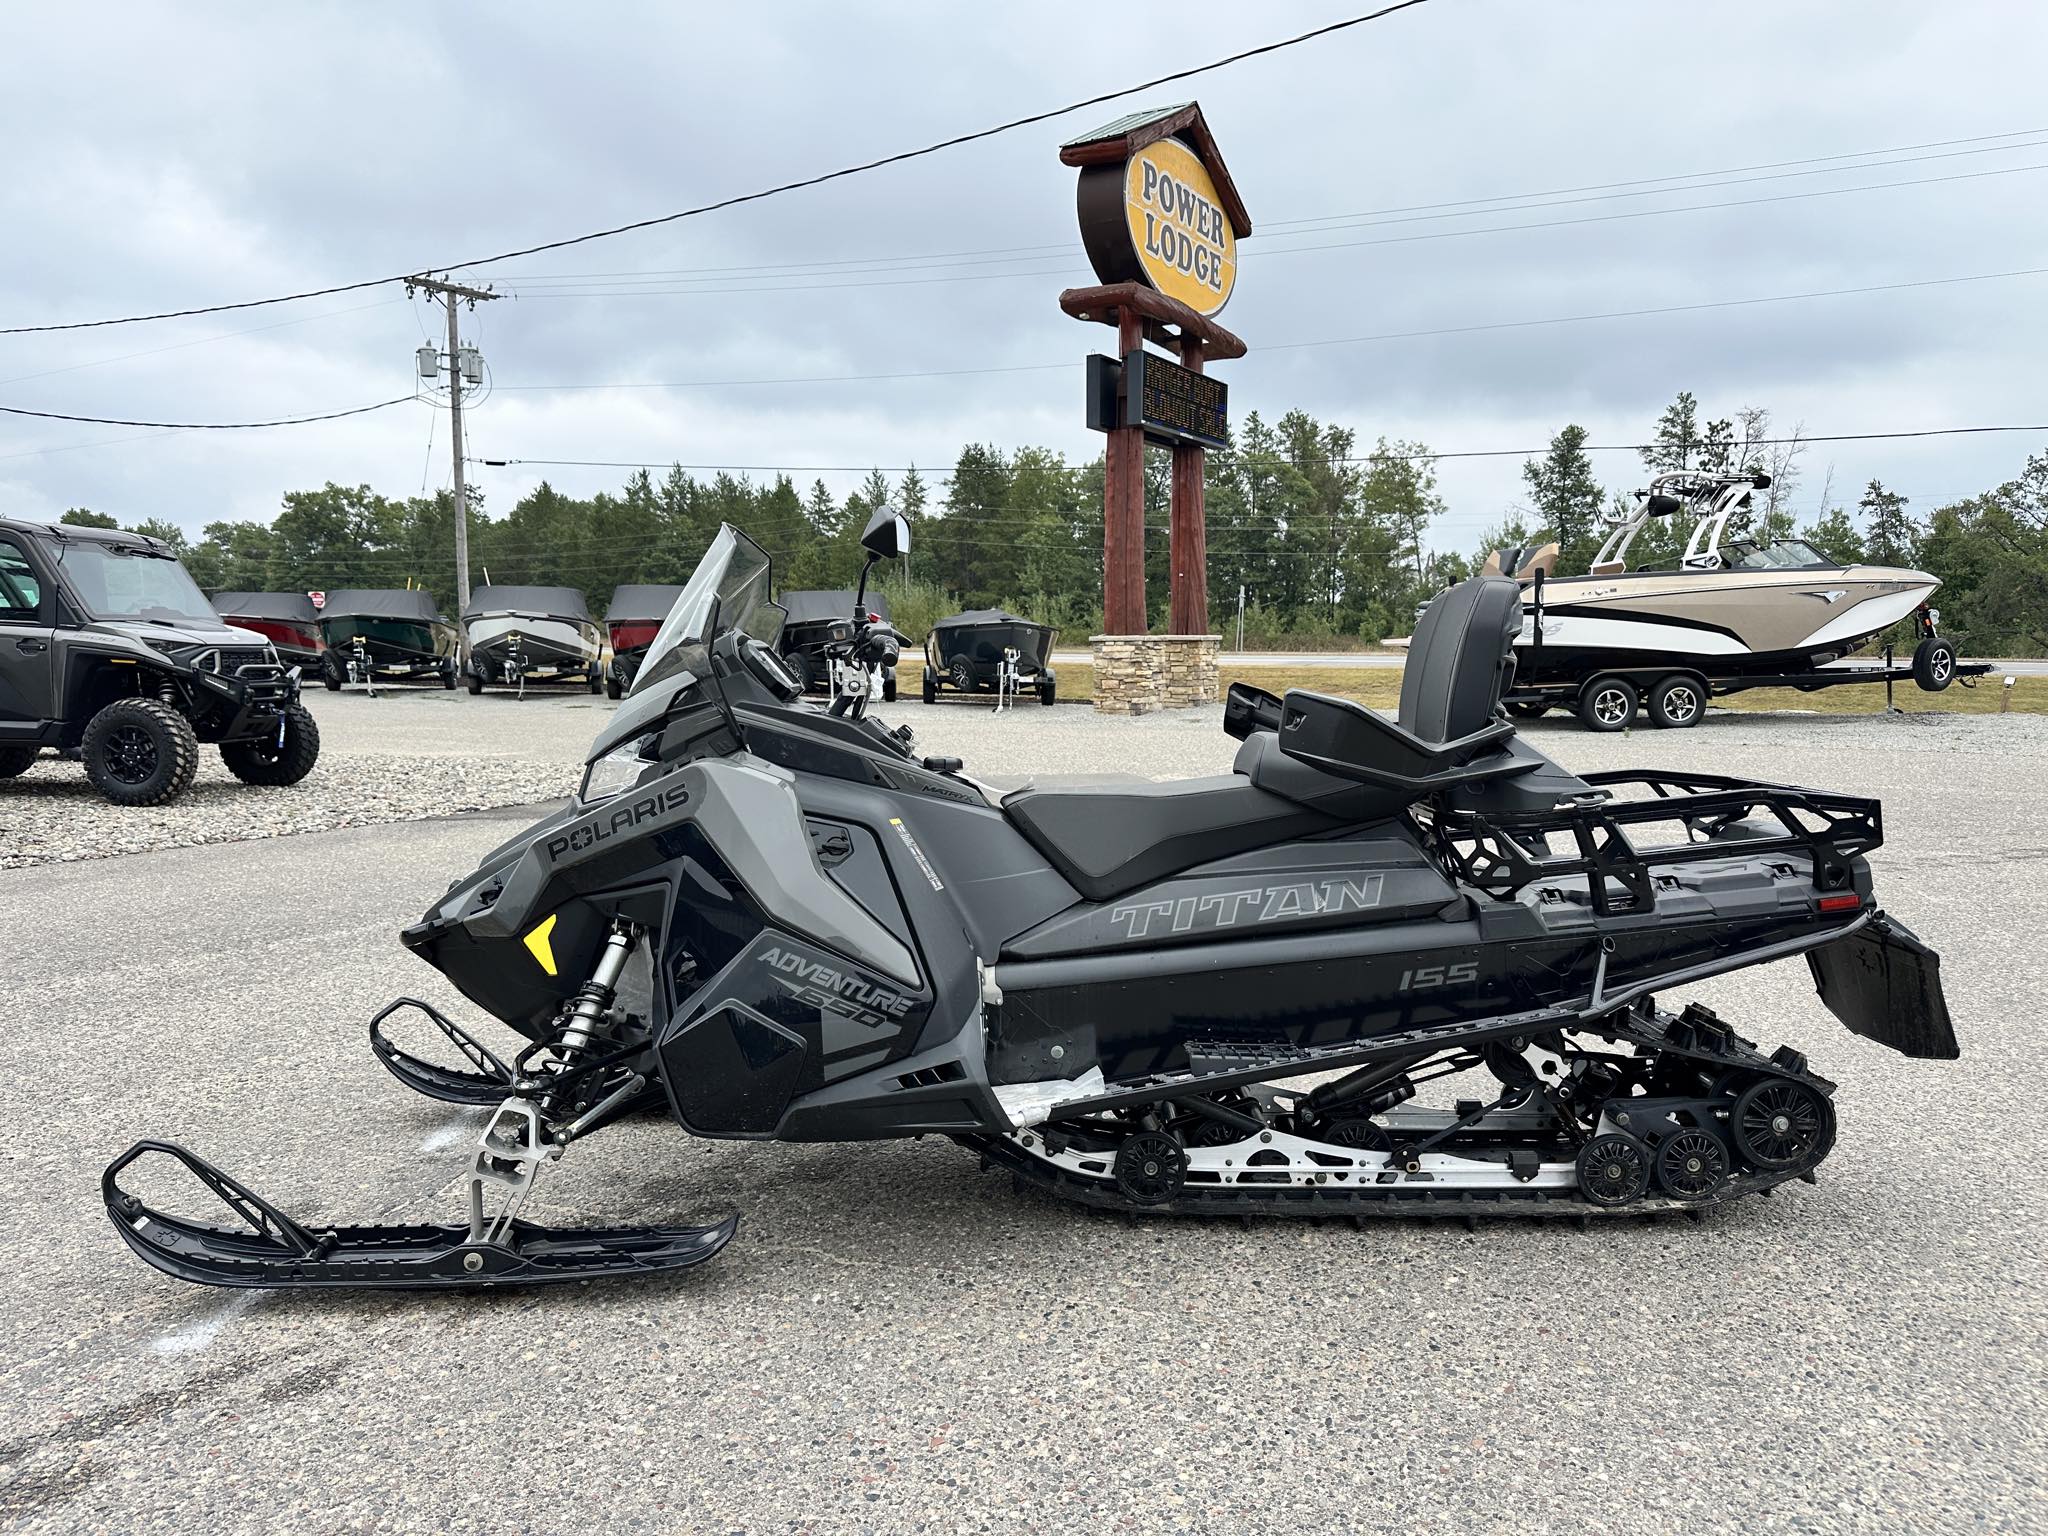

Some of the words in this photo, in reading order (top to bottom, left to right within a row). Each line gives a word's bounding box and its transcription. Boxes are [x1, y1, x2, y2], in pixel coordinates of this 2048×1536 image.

[1142, 160, 1225, 249] POWER
[1145, 212, 1222, 291] LODGE
[1146, 356, 1192, 399] RANGER
[1194, 376, 1222, 410] BOAT
[1143, 387, 1198, 430] BLOWOUT
[1199, 407, 1226, 440] SALE
[547, 782, 690, 863] POLARIS
[921, 784, 975, 803] MATRYX
[1110, 873, 1385, 939] TITAN
[757, 946, 915, 1018] ADVENTURE
[1399, 961, 1480, 991] 155
[793, 985, 888, 1029] 650
